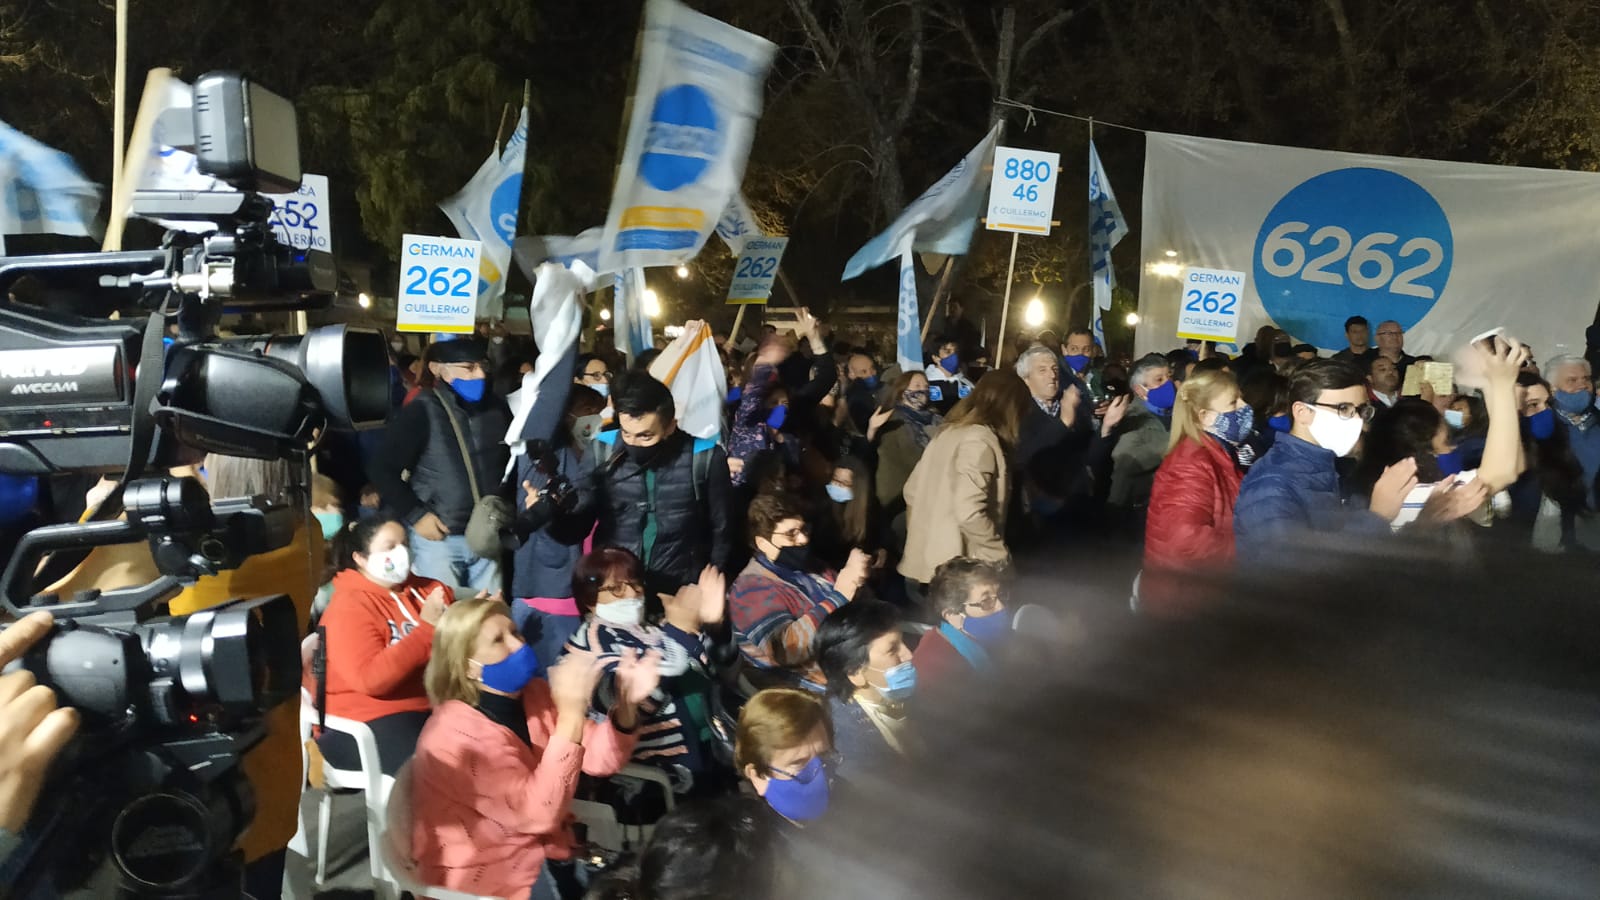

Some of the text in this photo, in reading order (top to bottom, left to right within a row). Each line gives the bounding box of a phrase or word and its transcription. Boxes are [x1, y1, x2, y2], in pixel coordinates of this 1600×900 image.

[1005, 158, 1051, 182] 880
[1012, 183, 1039, 202] 46
[408, 243, 475, 259] GERMAN
[1261, 221, 1444, 299] 6262
[736, 256, 777, 278] 262
[405, 265, 472, 297] 262
[1190, 272, 1240, 285] GERMAN
[404, 303, 470, 314] GUILLERMO
[1185, 289, 1237, 315] 262
[10, 381, 79, 395] AVCCAM
